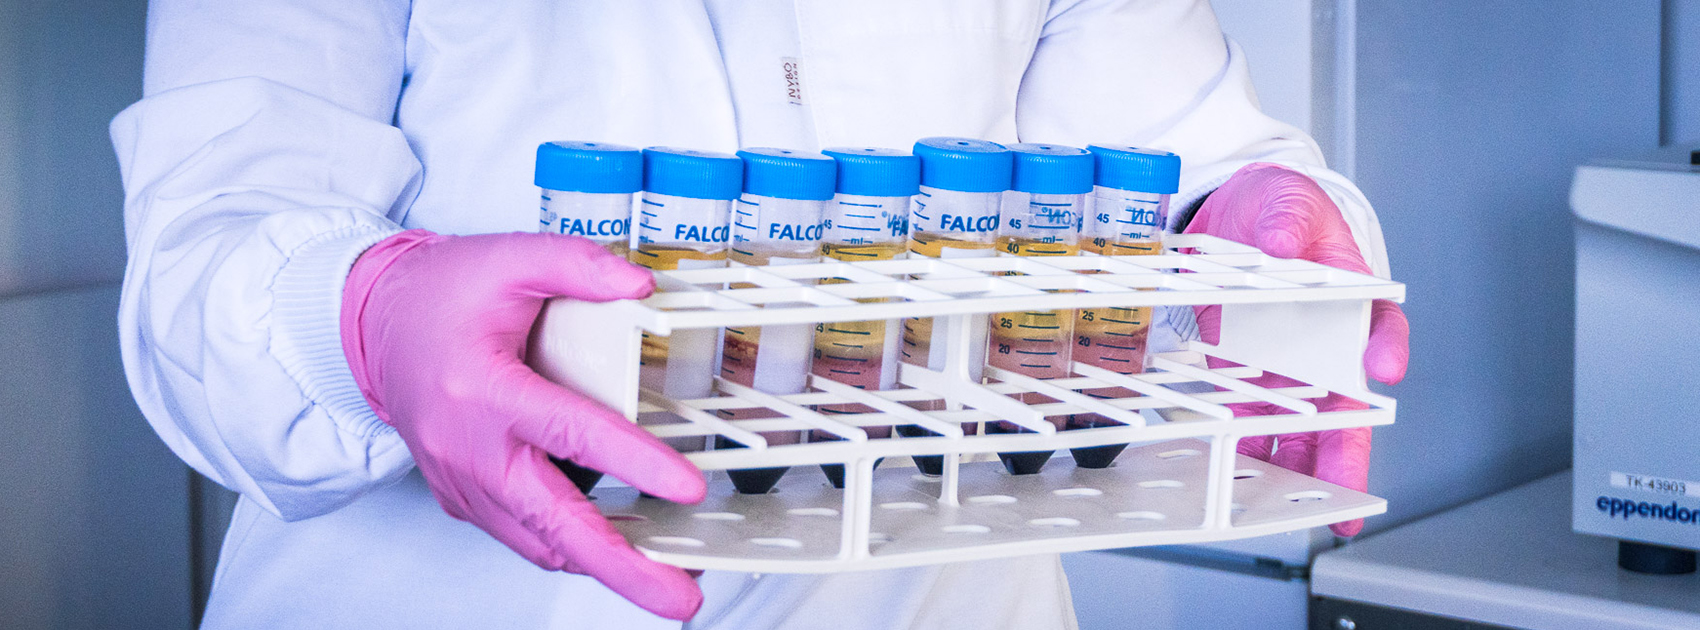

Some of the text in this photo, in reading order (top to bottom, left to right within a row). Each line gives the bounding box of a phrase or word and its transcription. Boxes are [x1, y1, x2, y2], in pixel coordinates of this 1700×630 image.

[784, 62, 796, 98] NYBO
[1008, 218, 1022, 229] 45
[1096, 212, 1110, 224] 45
[674, 224, 730, 242] FALCO
[769, 222, 824, 241] FALCO
[1006, 242, 1020, 254] 40
[1093, 238, 1106, 248] 40
[1082, 311, 1095, 322] 25
[1000, 317, 1013, 329] 25
[1078, 336, 1091, 347] 20
[998, 343, 1011, 355] 20
[1626, 474, 1686, 495] TK-43903
[1596, 495, 1700, 525] eppendor
